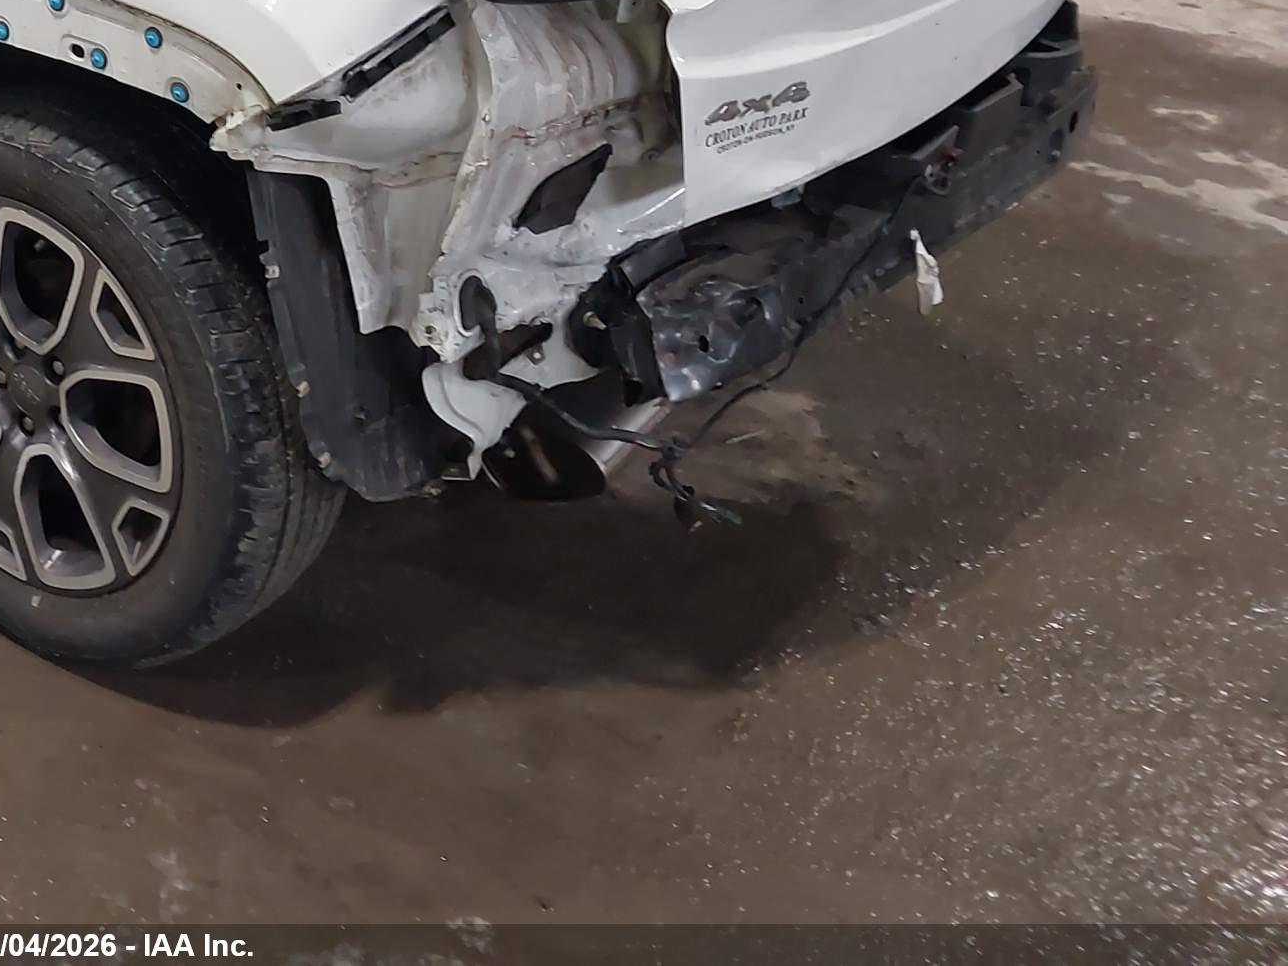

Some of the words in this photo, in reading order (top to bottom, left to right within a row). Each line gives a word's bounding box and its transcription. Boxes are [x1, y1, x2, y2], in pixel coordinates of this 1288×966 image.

[705, 123, 748, 148] CROTON
[747, 115, 778, 134] AUTO
[778, 107, 809, 125] PARK
